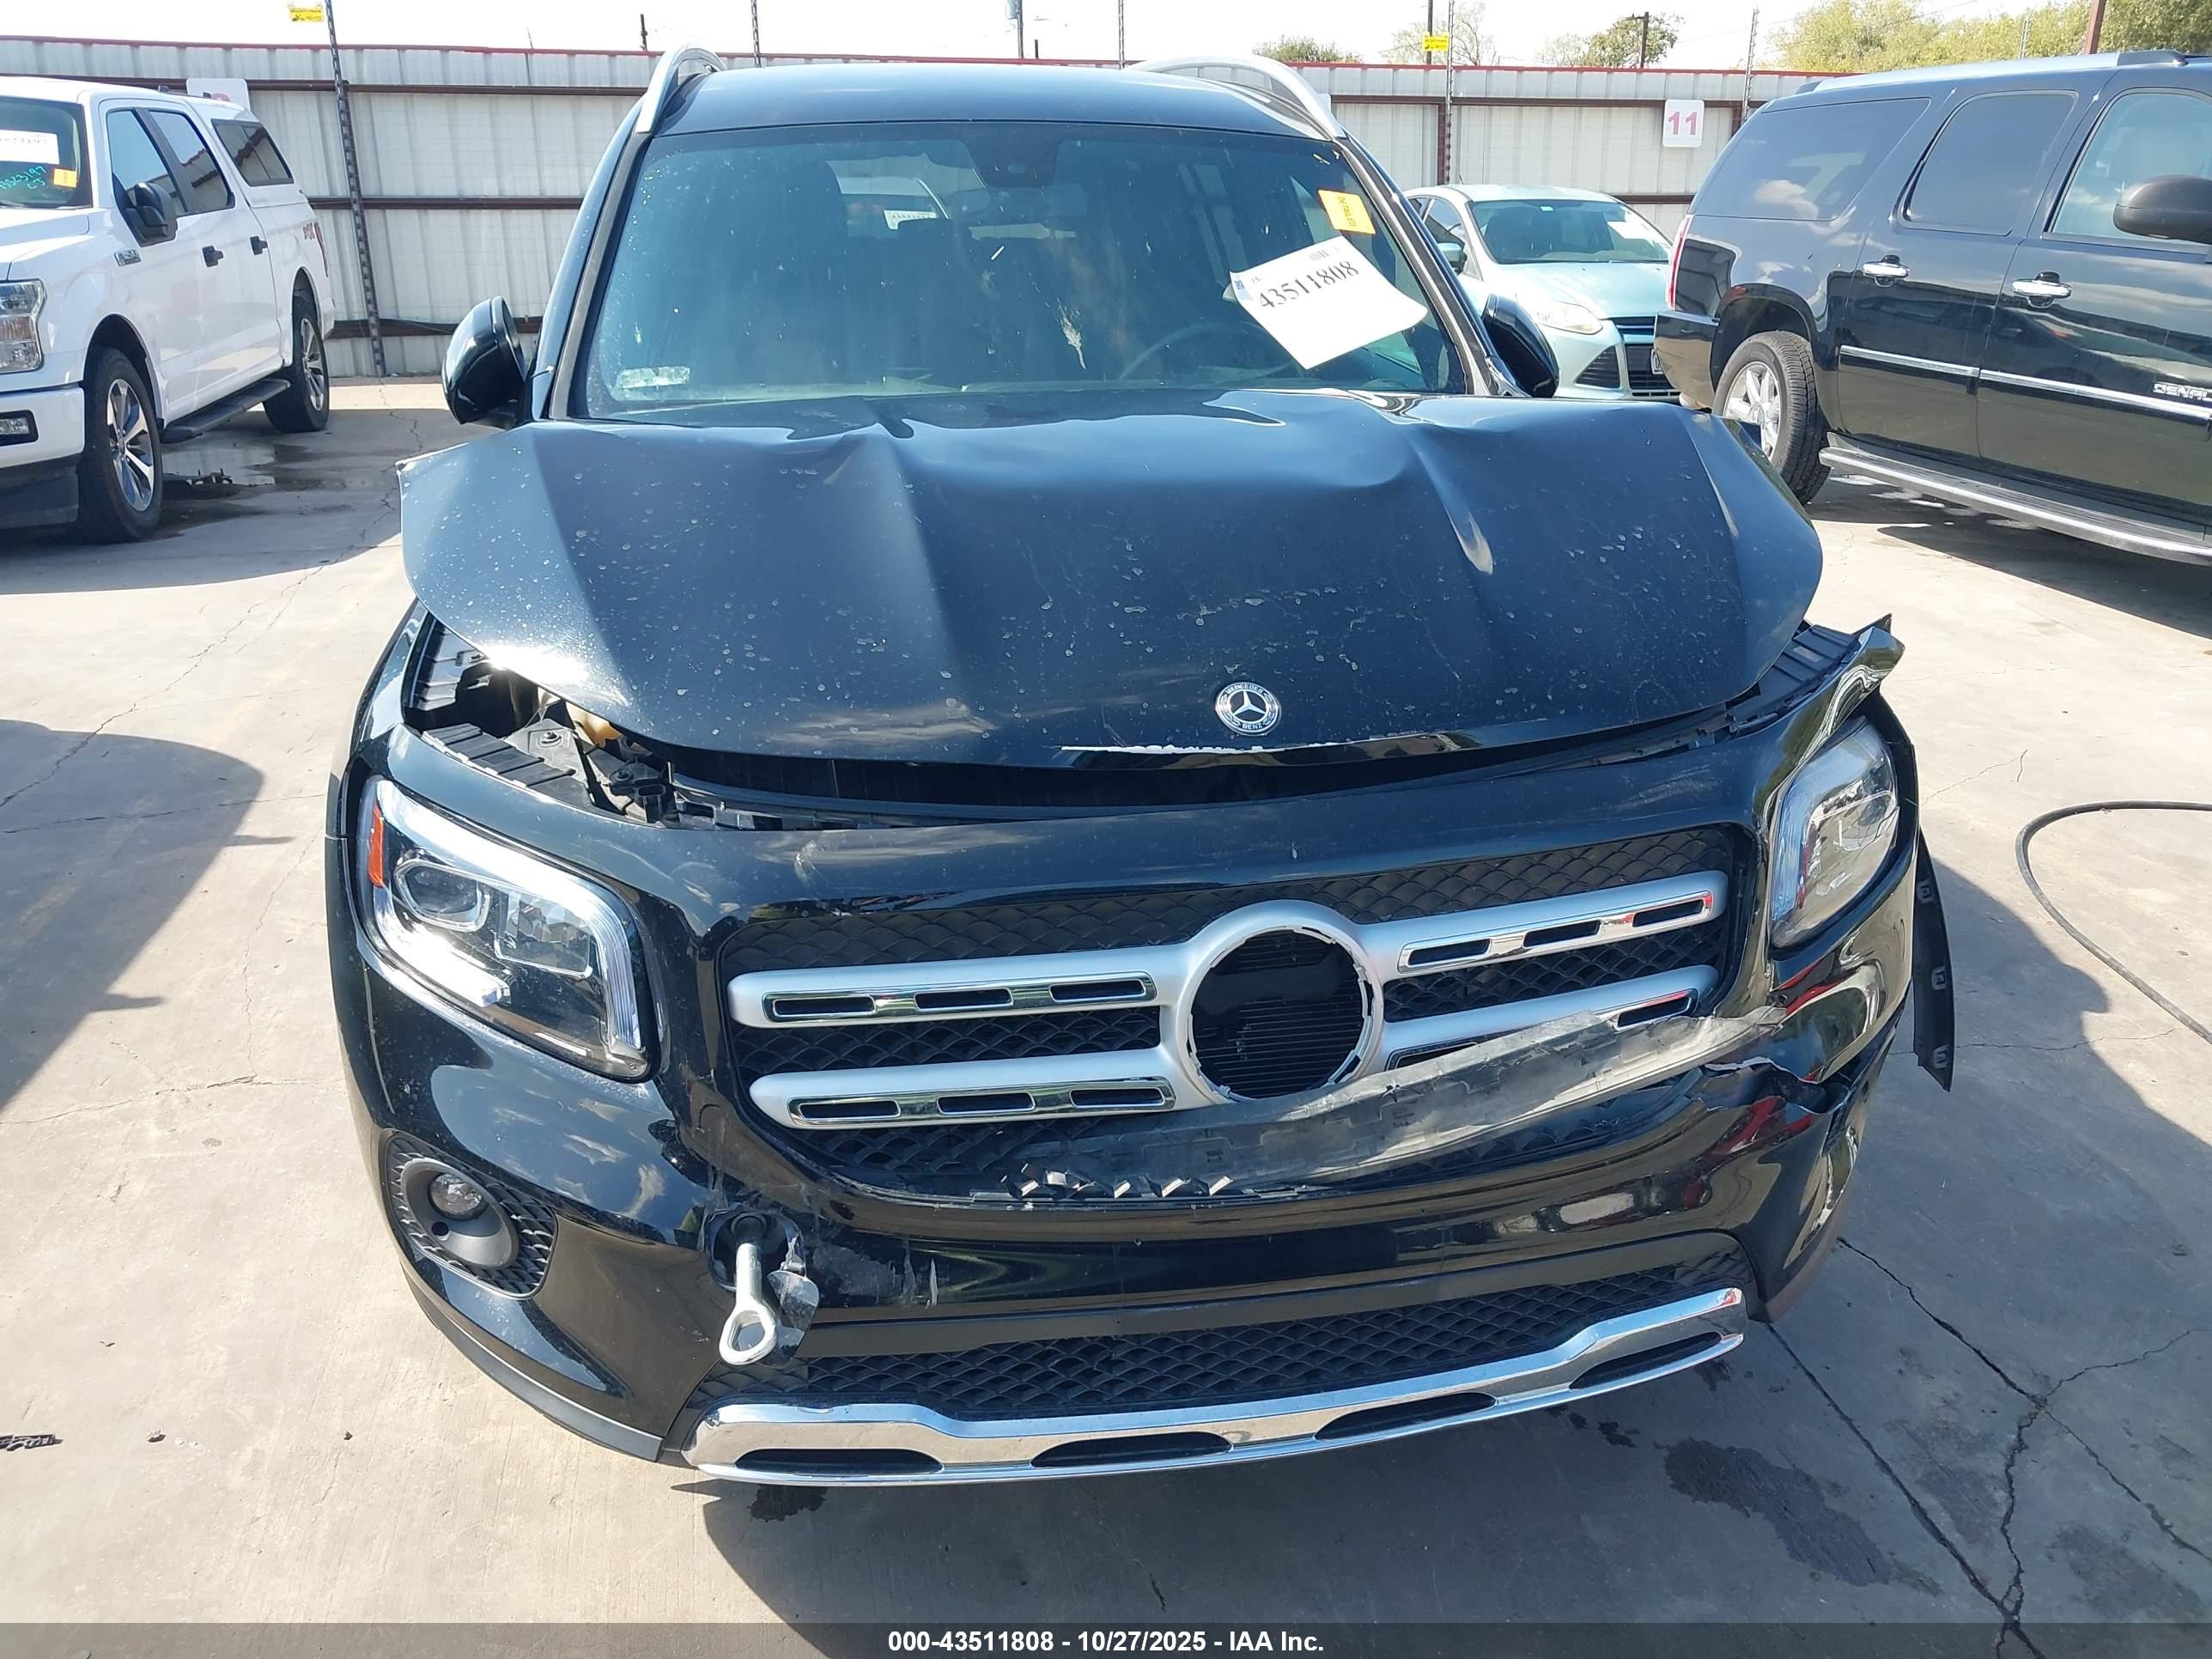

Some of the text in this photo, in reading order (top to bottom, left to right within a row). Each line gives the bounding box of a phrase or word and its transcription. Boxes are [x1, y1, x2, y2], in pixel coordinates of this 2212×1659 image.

[1668, 112, 1697, 135] 11
[1337, 196, 1357, 227] DETAILED
[1260, 260, 1359, 307] 43511808
